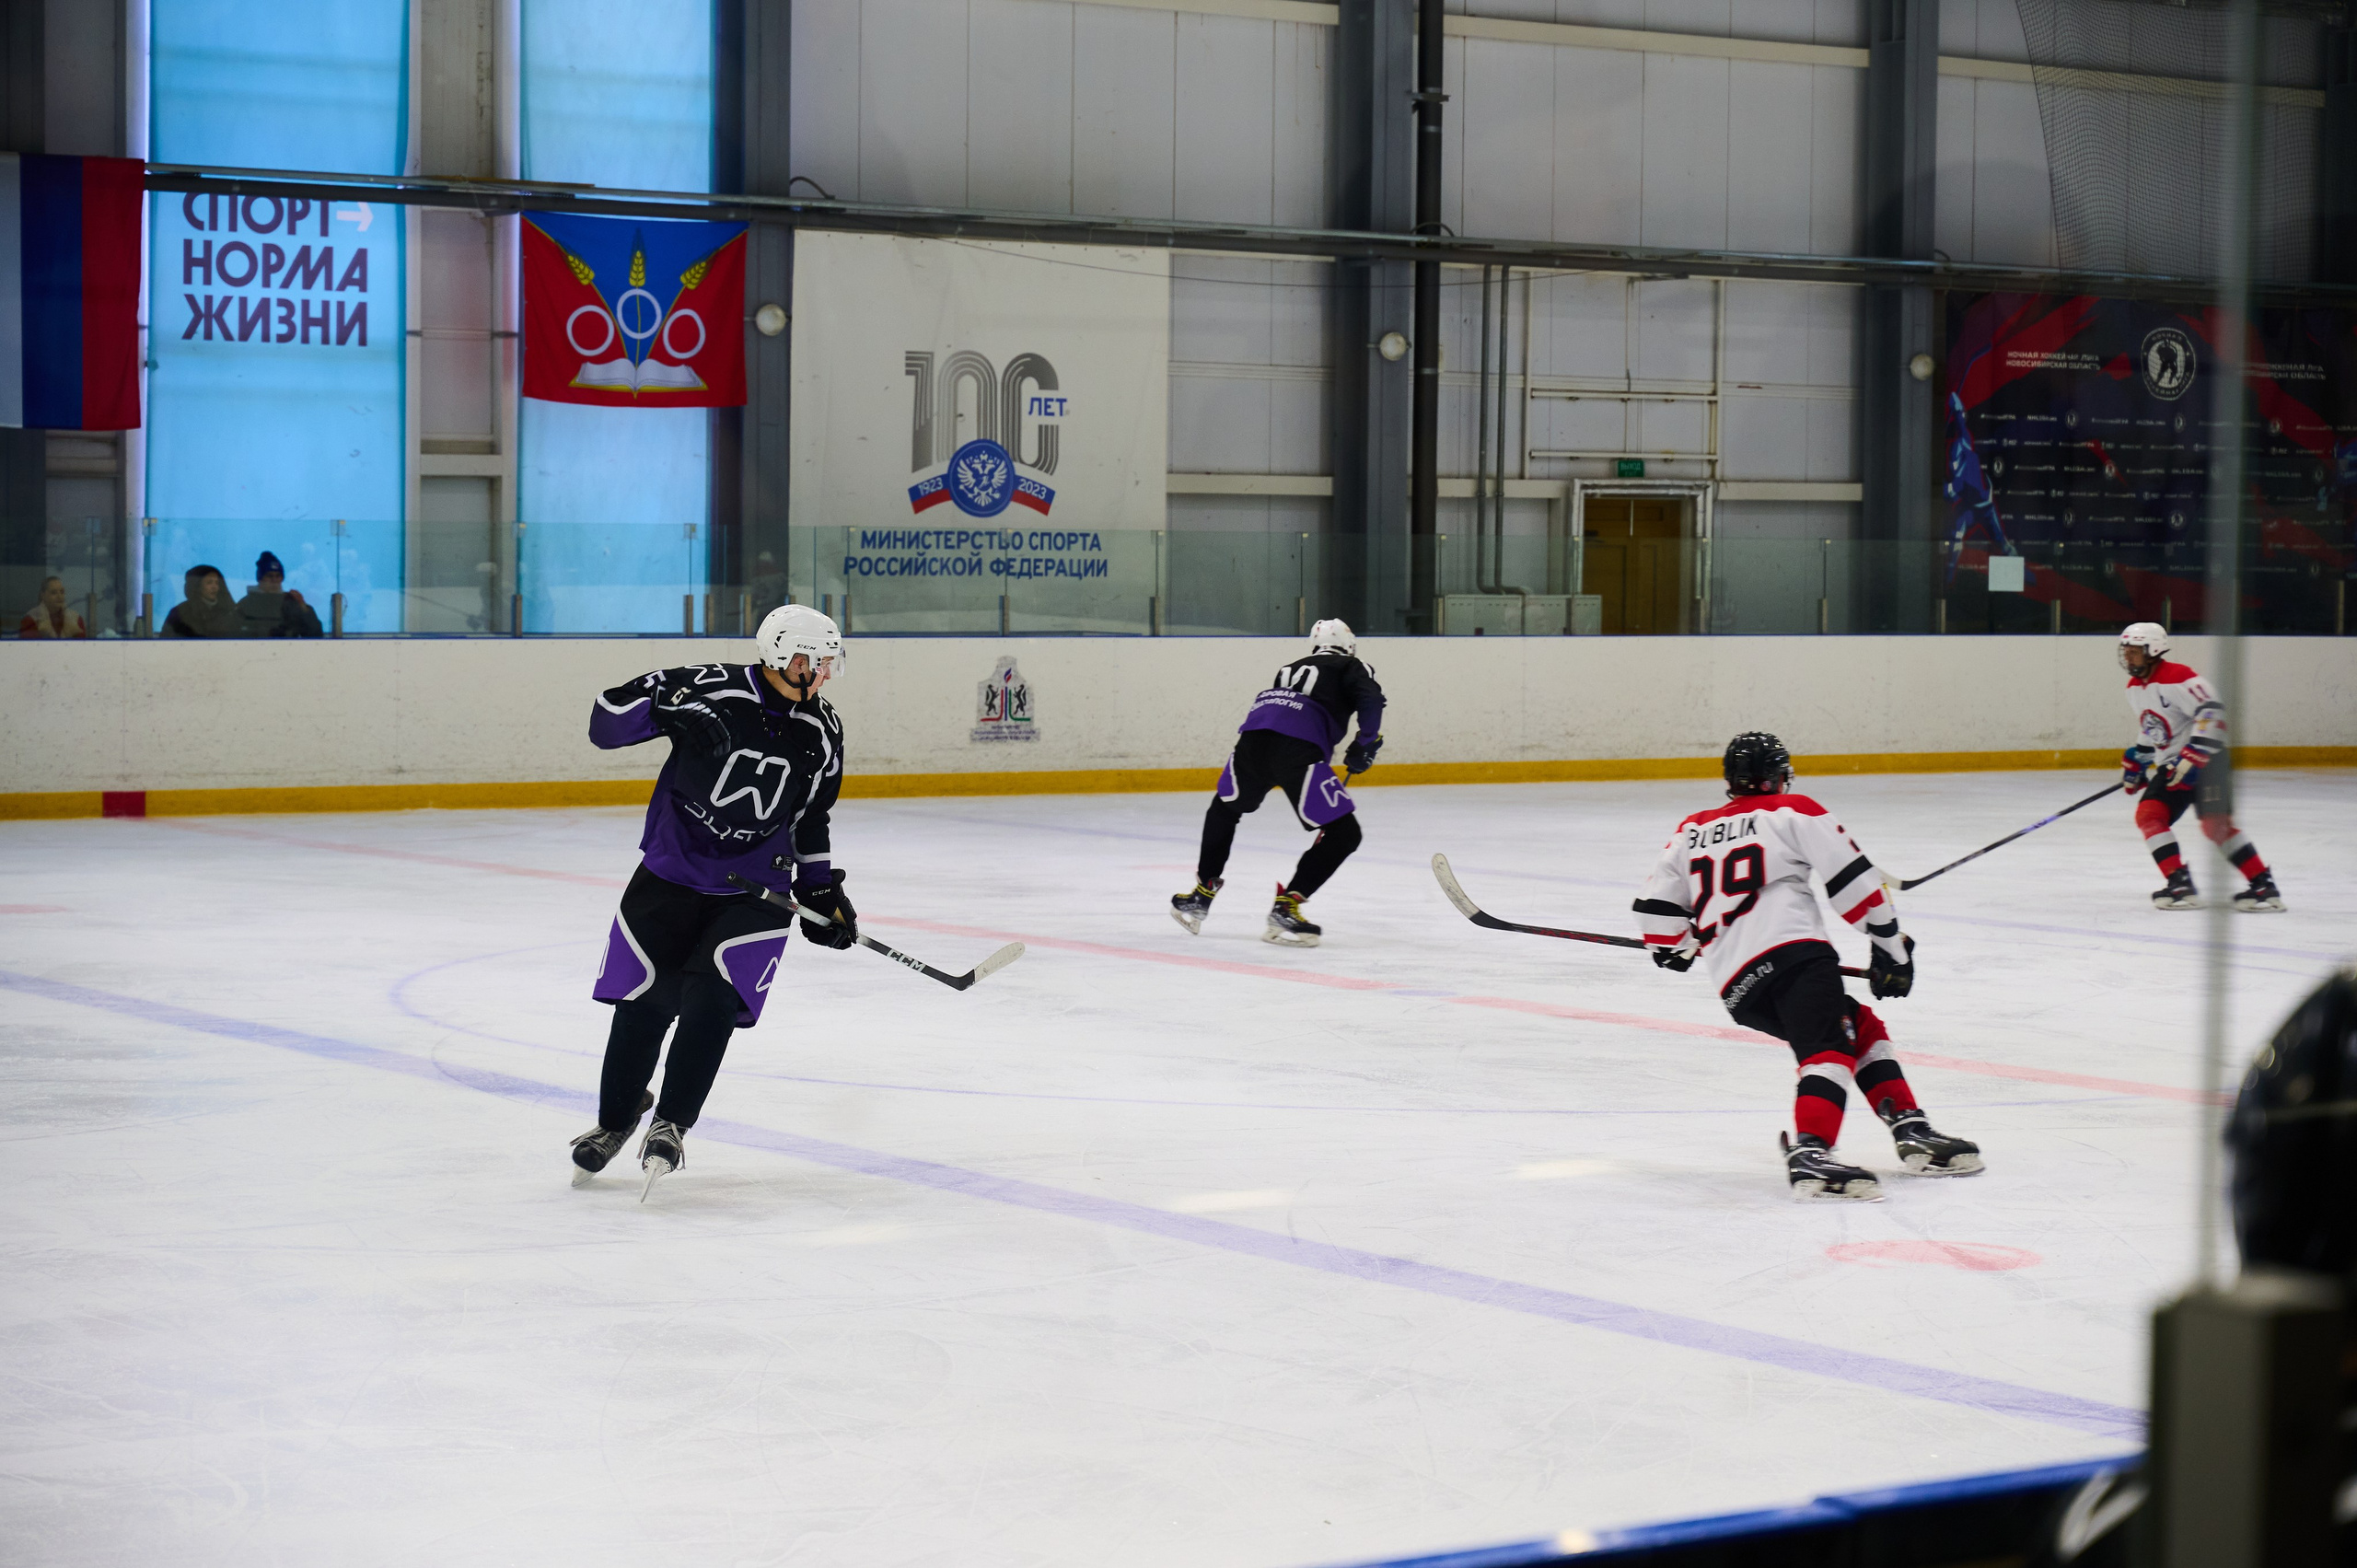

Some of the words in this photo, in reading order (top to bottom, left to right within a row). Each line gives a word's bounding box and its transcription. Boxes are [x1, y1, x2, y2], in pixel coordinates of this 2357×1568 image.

[182, 192, 338, 238] СПОРТ
[182, 238, 368, 293] НОРМА
[181, 293, 368, 347] ЖИЗНИ
[2007, 351, 2038, 359] НОЧНАЯ
[1028, 397, 1068, 417] ЛЕТ
[918, 477, 944, 496] 1923
[1018, 478, 1048, 500] 2023
[1028, 531, 1102, 552] СПОРТА
[843, 552, 983, 576] РОССИЙСКОЙ
[989, 557, 1109, 580] ФЕДЕРАЦИИ
[811, 888, 831, 896] CCM
[887, 948, 927, 972] CCM
